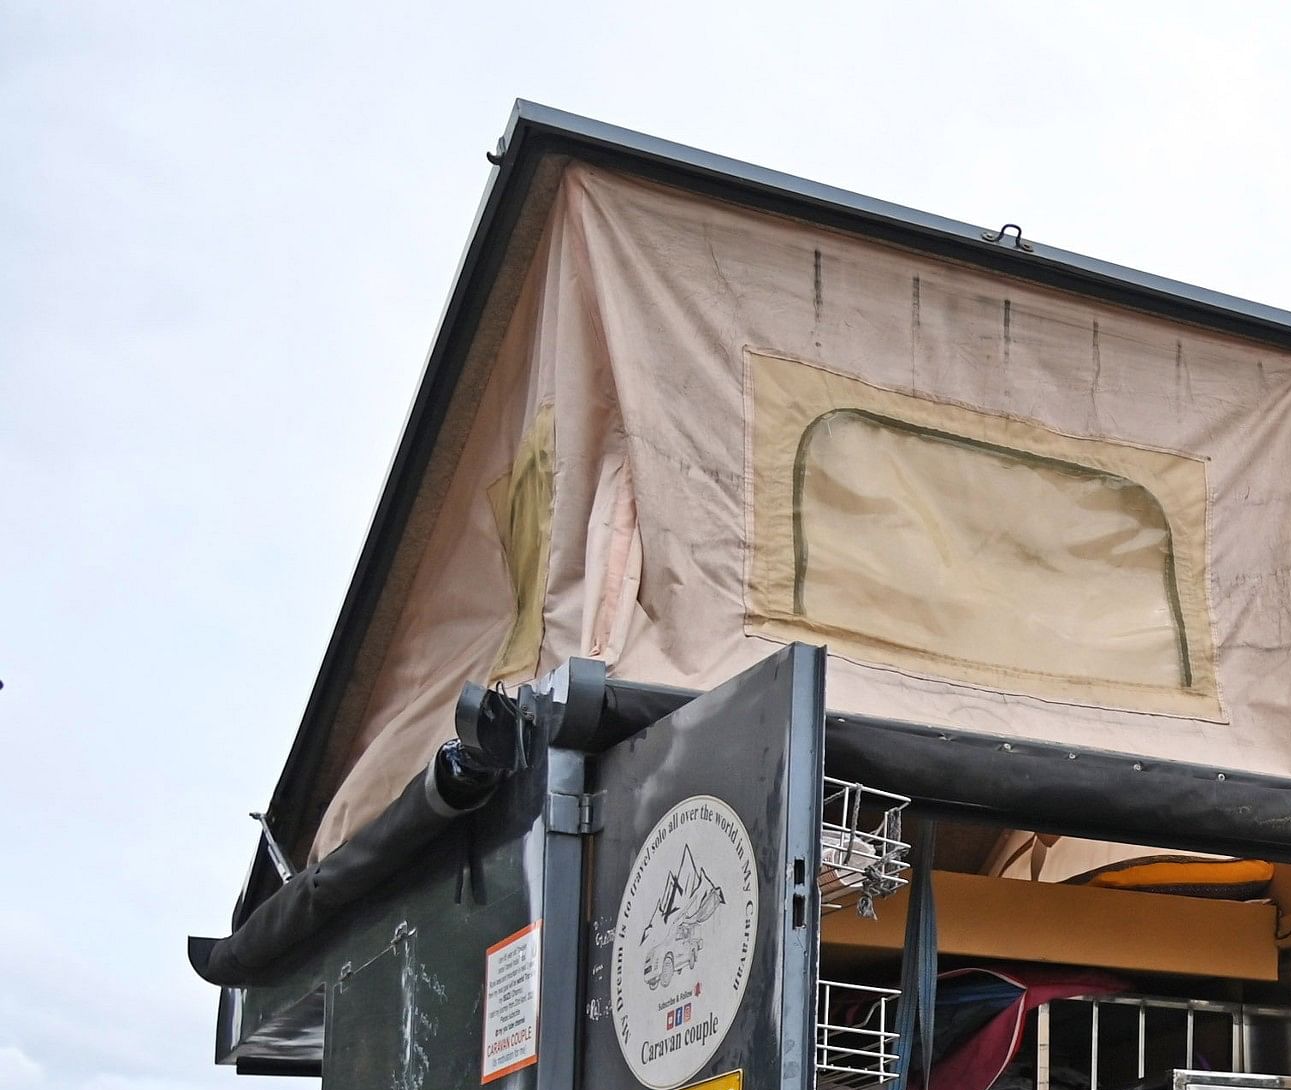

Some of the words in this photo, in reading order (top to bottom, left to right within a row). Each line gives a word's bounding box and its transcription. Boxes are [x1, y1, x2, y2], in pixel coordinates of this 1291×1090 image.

[668, 814, 679, 834] all
[680, 808, 699, 825] over
[700, 804, 714, 822] the
[715, 811, 739, 844] world
[651, 828, 667, 854] solo
[736, 838, 744, 861] in
[630, 850, 651, 897] travel
[741, 859, 752, 892] My
[624, 902, 632, 918] to
[619, 925, 627, 938] is
[733, 900, 754, 991] Caravan
[616, 947, 624, 1012] Dream
[487, 1034, 511, 1057] CARAVAN
[511, 1026, 533, 1049] COUPLE
[621, 1014, 631, 1045] My
[640, 1032, 682, 1065] Caravan
[684, 1011, 719, 1046] couple
